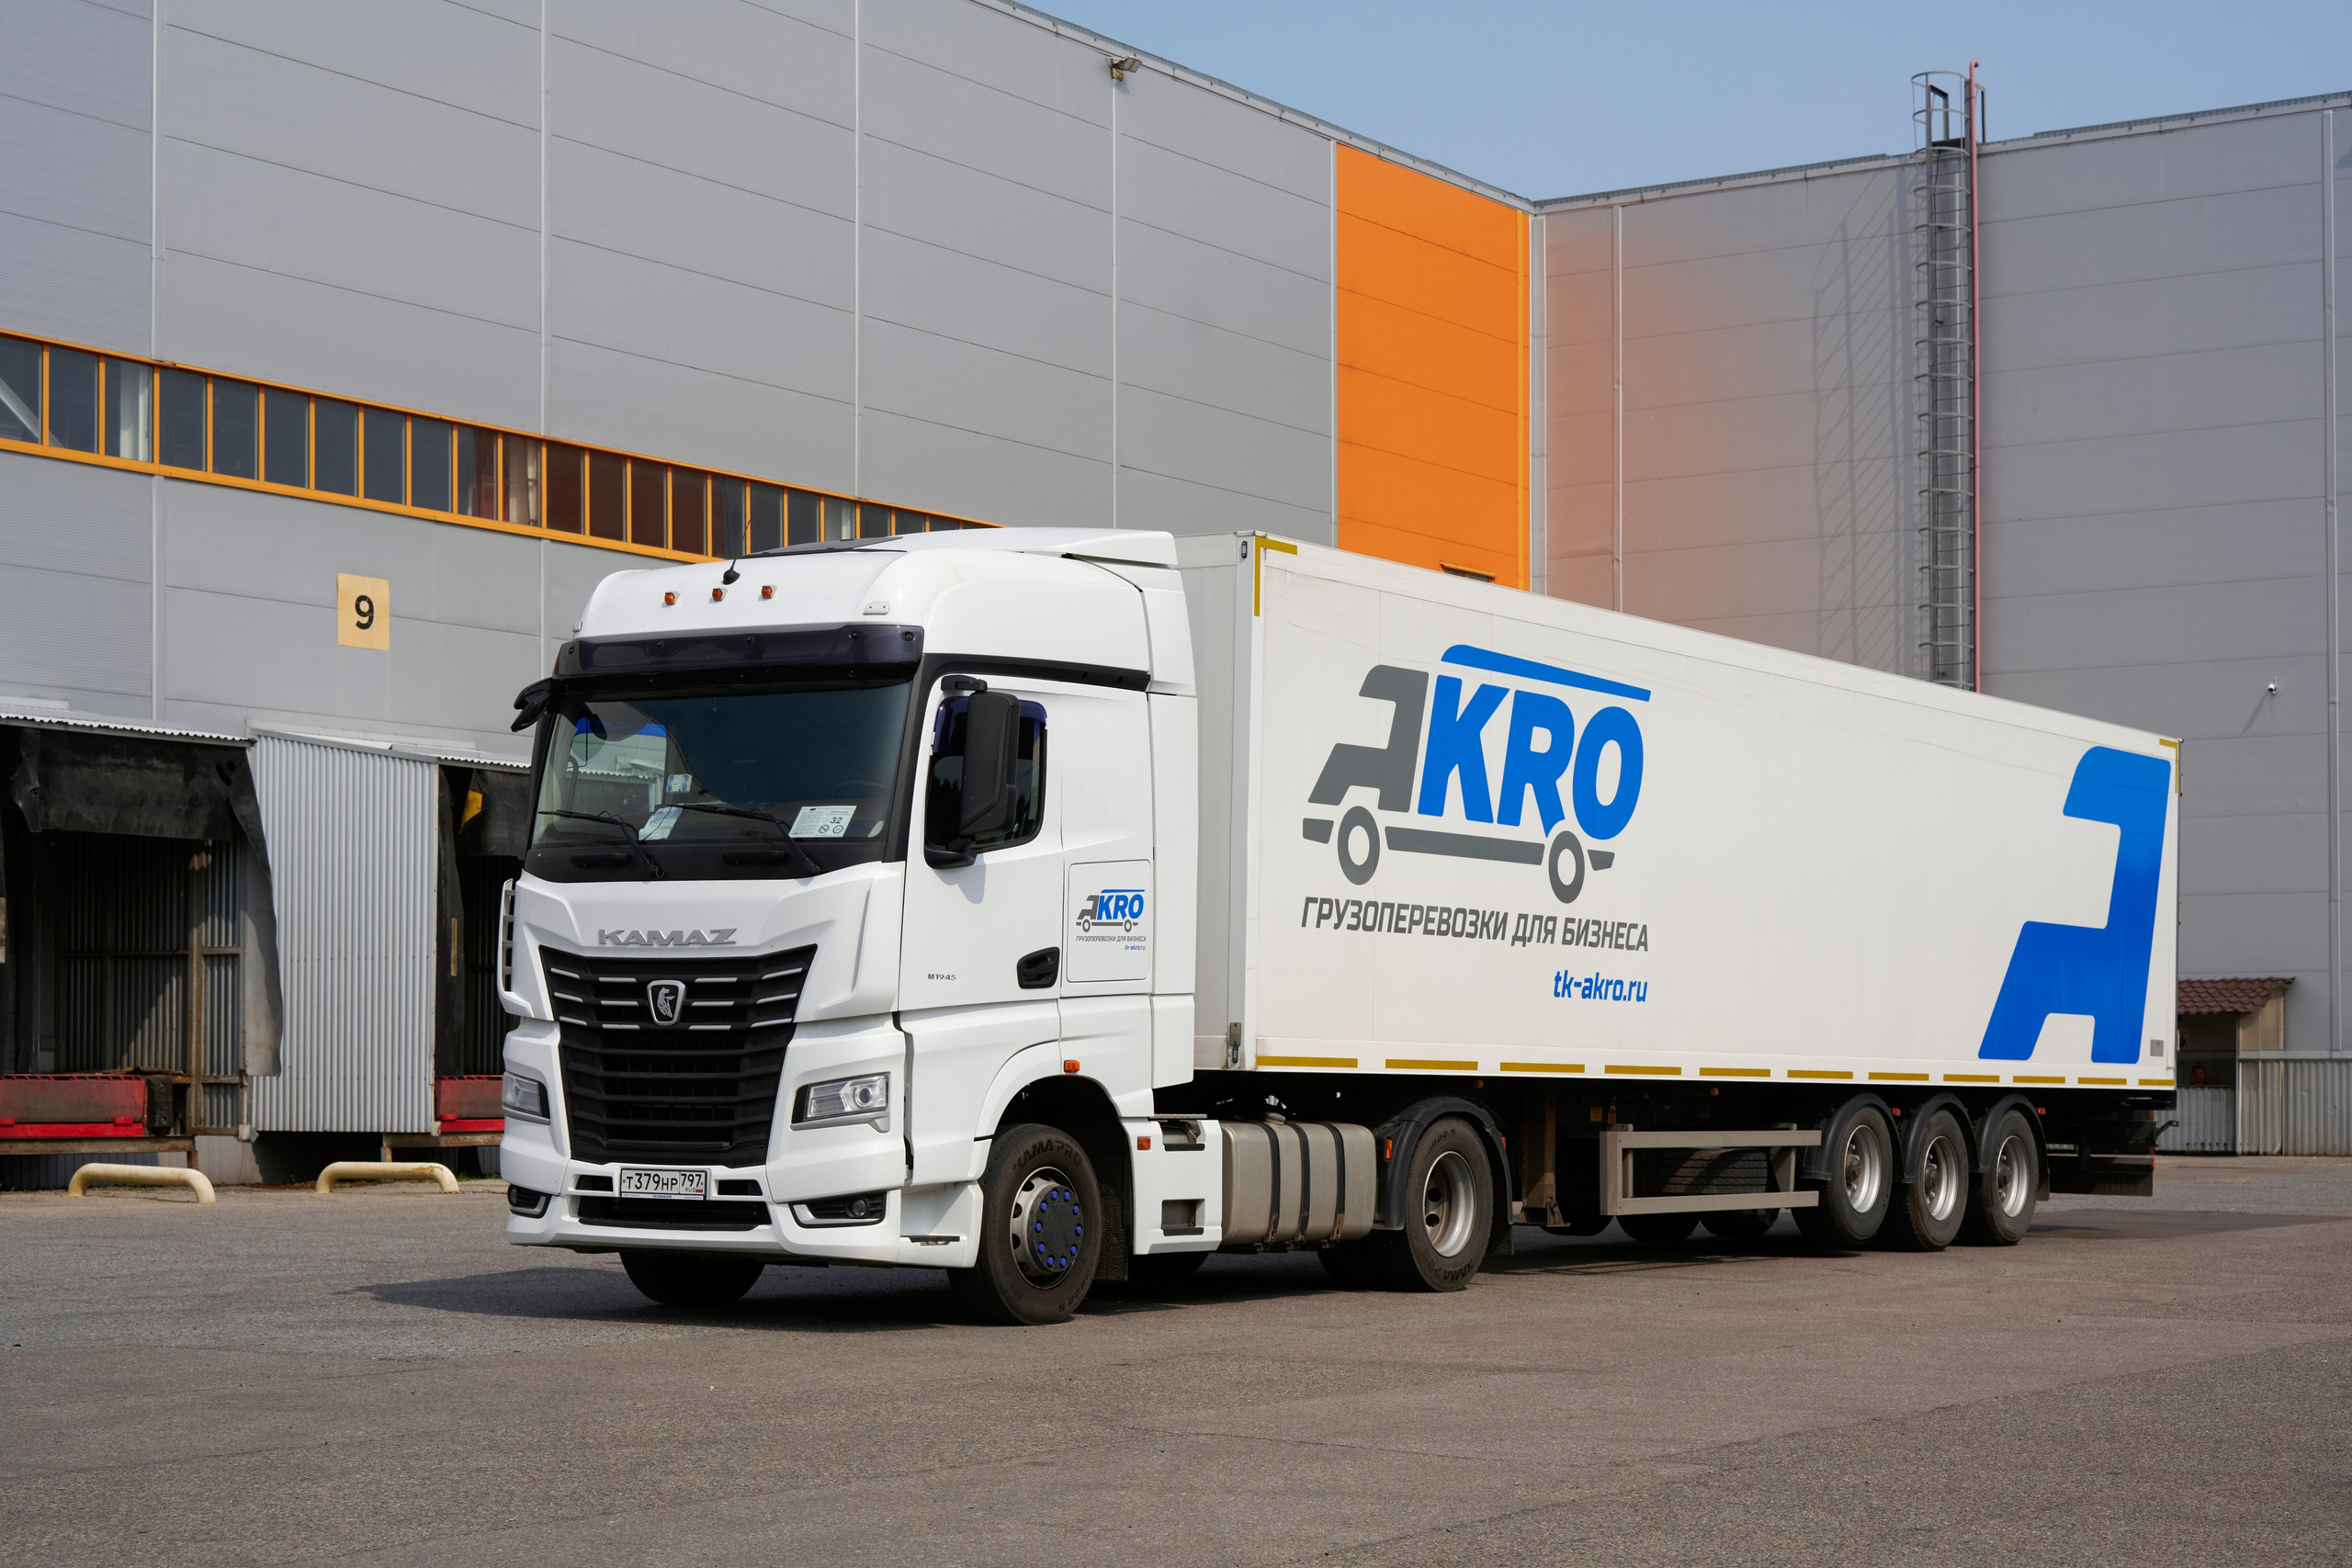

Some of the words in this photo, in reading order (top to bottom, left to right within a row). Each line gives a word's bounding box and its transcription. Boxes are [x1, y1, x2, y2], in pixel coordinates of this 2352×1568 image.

[355, 595, 374, 630] 9
[598, 928, 738, 946] KAMAZ
[1301, 897, 1509, 941] ГРУЗОПЕРЕВОЗКИ
[1510, 913, 1558, 948] ДЛЯ
[1561, 918, 1649, 952] БИЗНЕСА
[927, 973, 956, 981] M1945
[1553, 969, 1648, 1002] tk-akro.ru
[680, 1173, 702, 1188] 797
